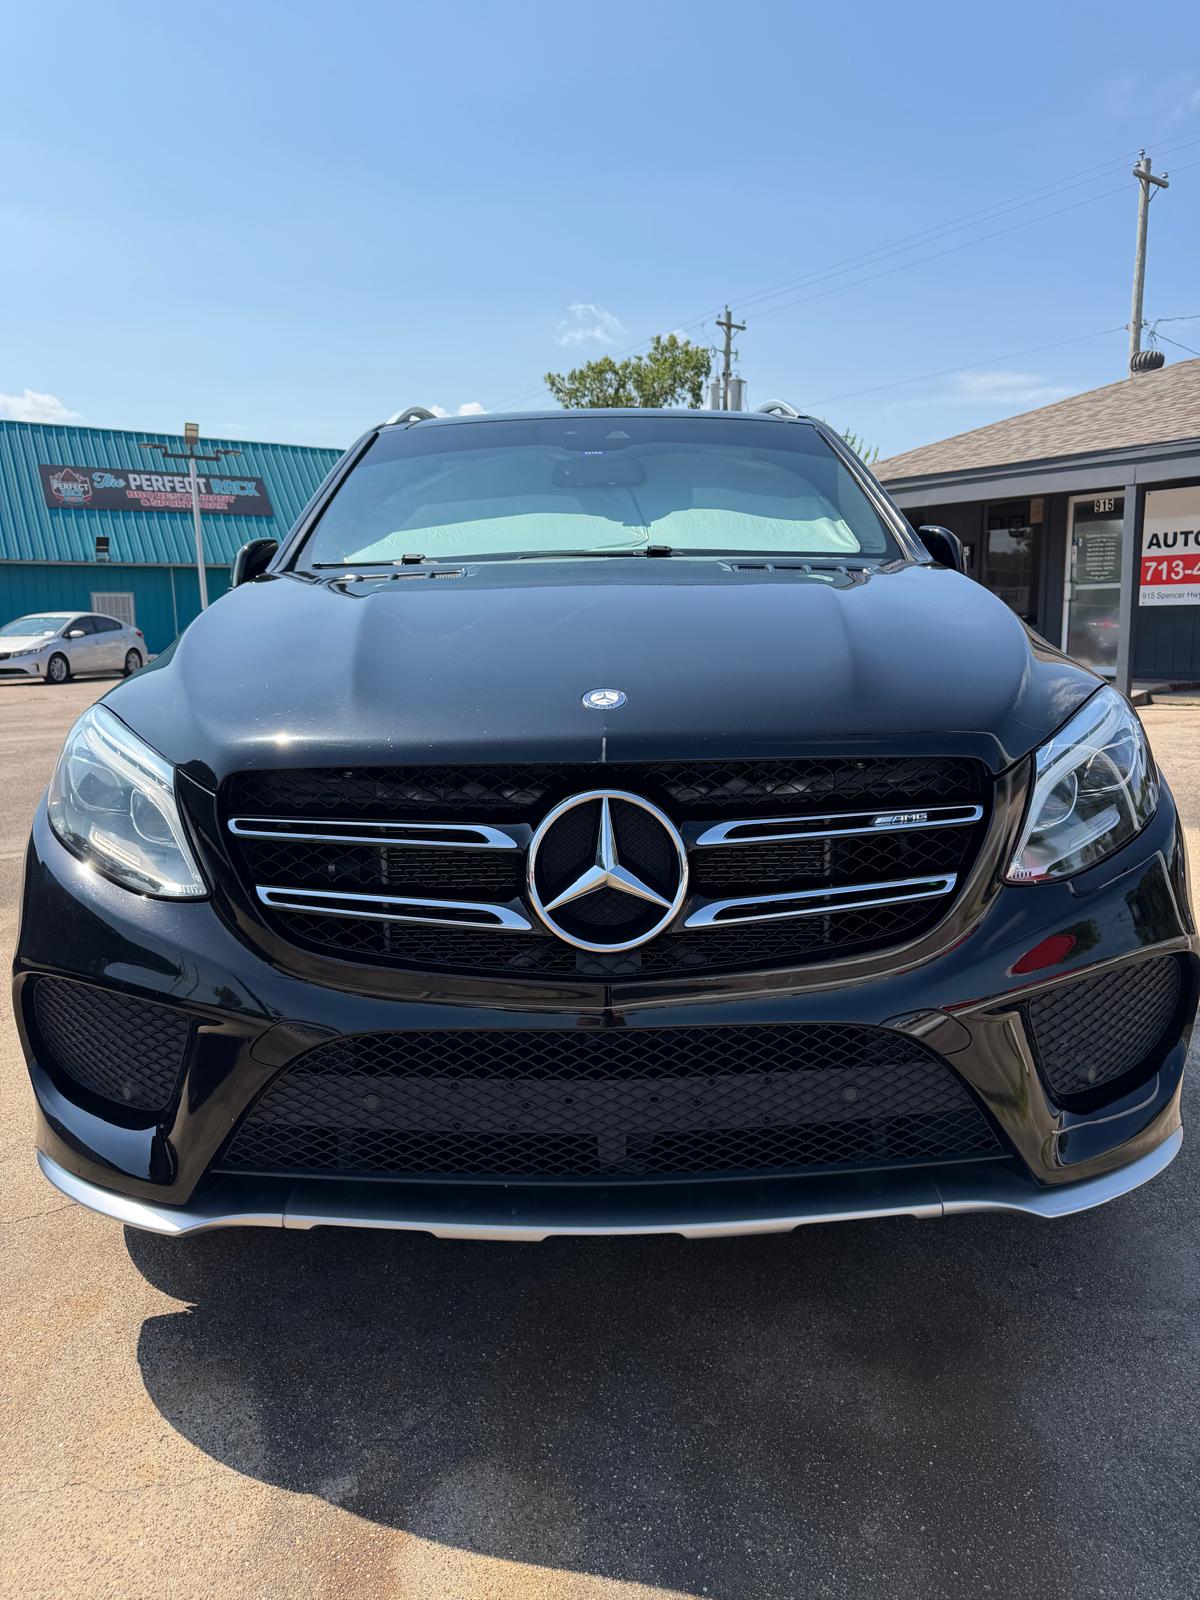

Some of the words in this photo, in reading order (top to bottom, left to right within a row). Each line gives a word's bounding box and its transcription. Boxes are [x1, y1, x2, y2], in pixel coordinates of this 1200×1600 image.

[92, 472, 126, 488] The
[127, 473, 206, 494] PERFECT
[210, 478, 260, 497] RACK
[1095, 498, 1114, 512] 915
[1156, 592, 1185, 600] Spencer
[891, 812, 928, 825] AMG
